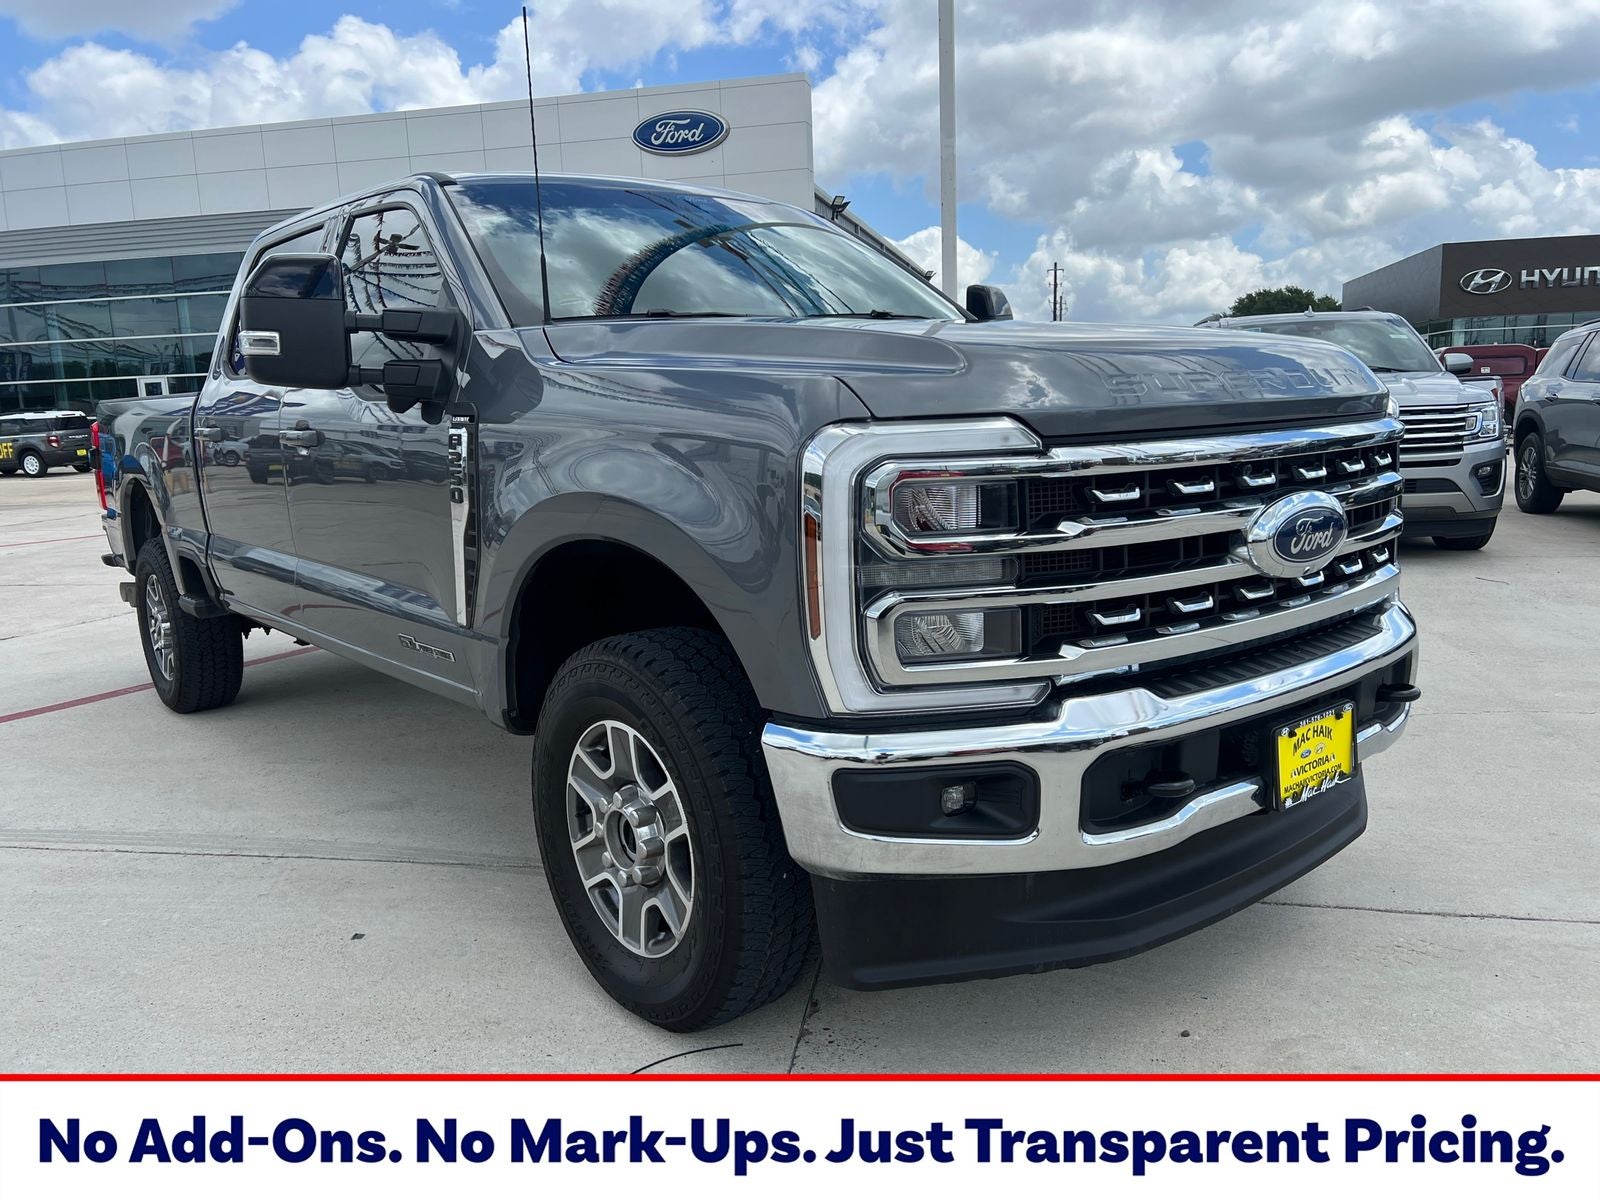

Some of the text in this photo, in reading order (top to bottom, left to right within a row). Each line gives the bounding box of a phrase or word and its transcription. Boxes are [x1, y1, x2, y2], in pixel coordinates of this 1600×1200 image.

[651, 118, 705, 146] Ford
[1520, 266, 1600, 289] HYUN
[1103, 369, 1286, 396] SUPER
[1291, 516, 1334, 554] Ford
[1293, 728, 1311, 757] MAC
[1312, 724, 1333, 741] HAIK
[1296, 754, 1330, 777] VICTORIA
[1300, 769, 1351, 802] Mac Haik
